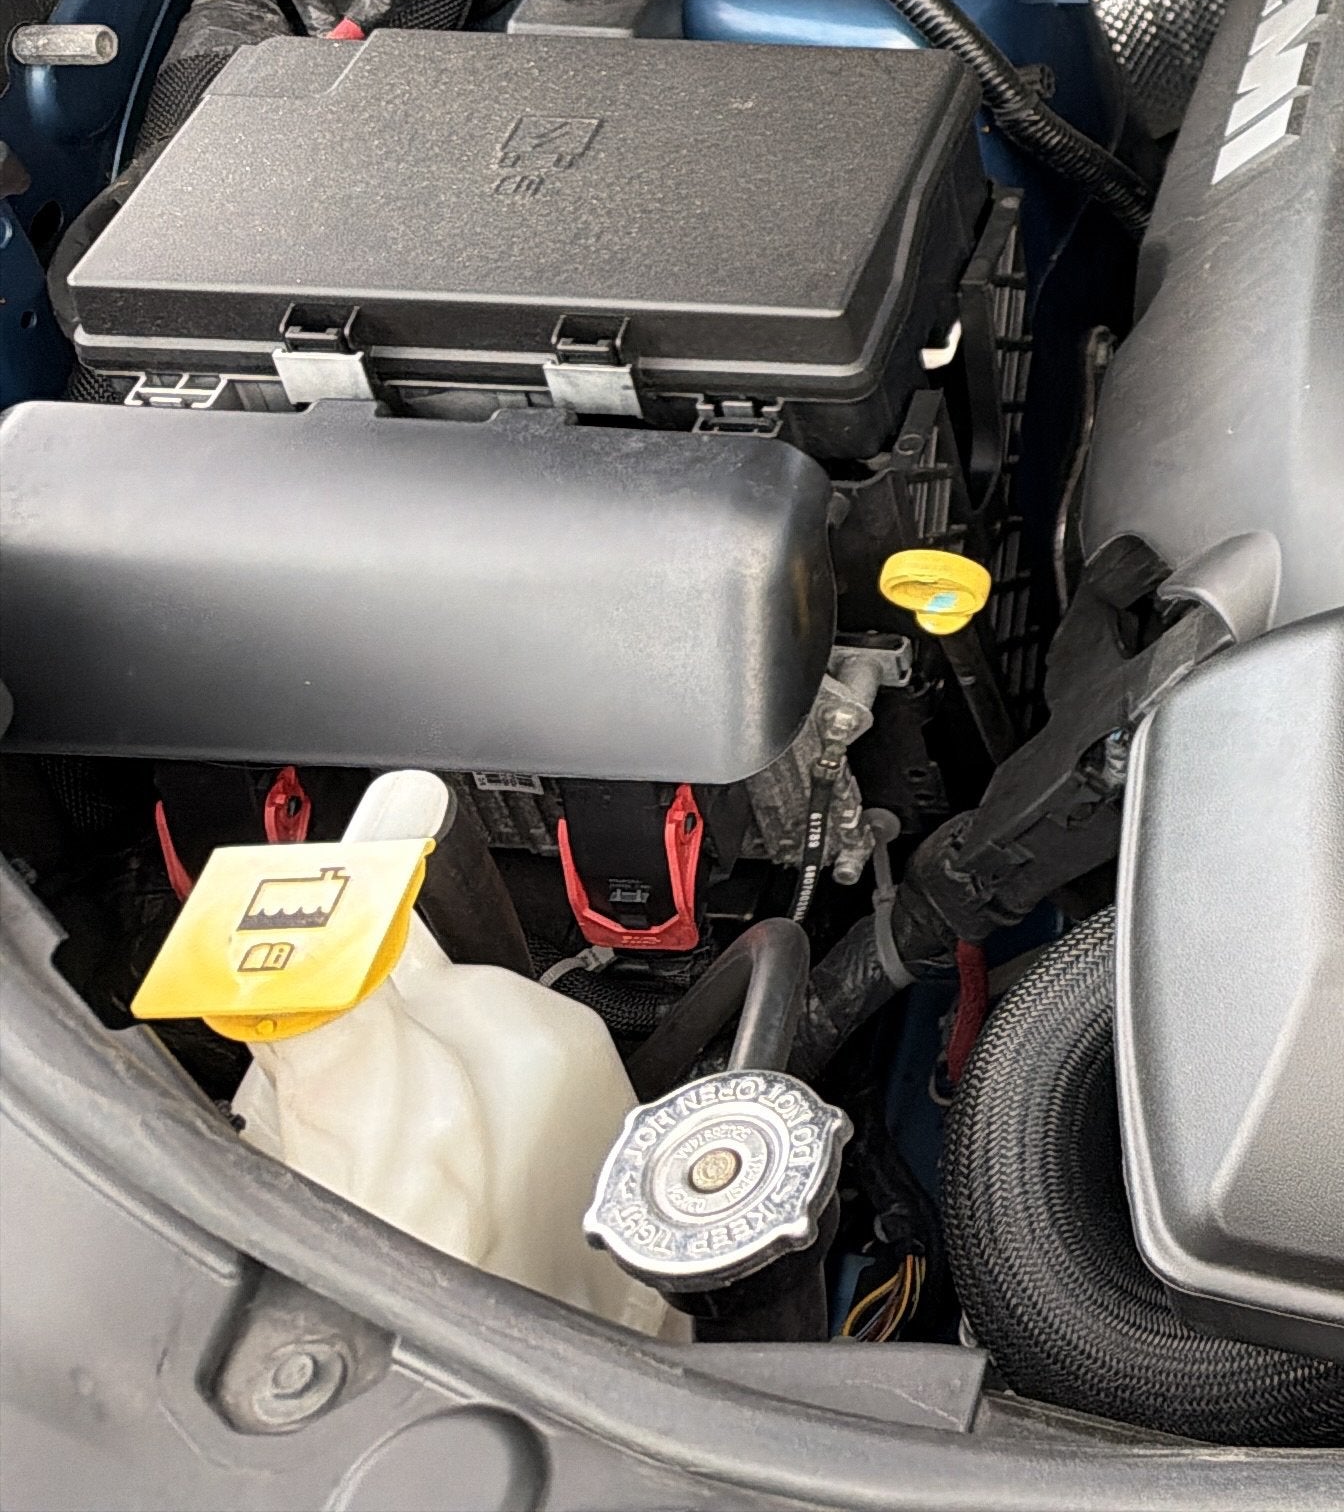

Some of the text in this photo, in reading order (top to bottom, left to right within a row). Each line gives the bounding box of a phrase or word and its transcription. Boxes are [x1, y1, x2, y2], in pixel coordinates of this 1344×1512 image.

[676, 1076, 766, 1115] OPEN
[759, 1083, 815, 1128] NOT
[623, 1108, 677, 1166] HOT
[688, 1200, 778, 1253] KEEP
